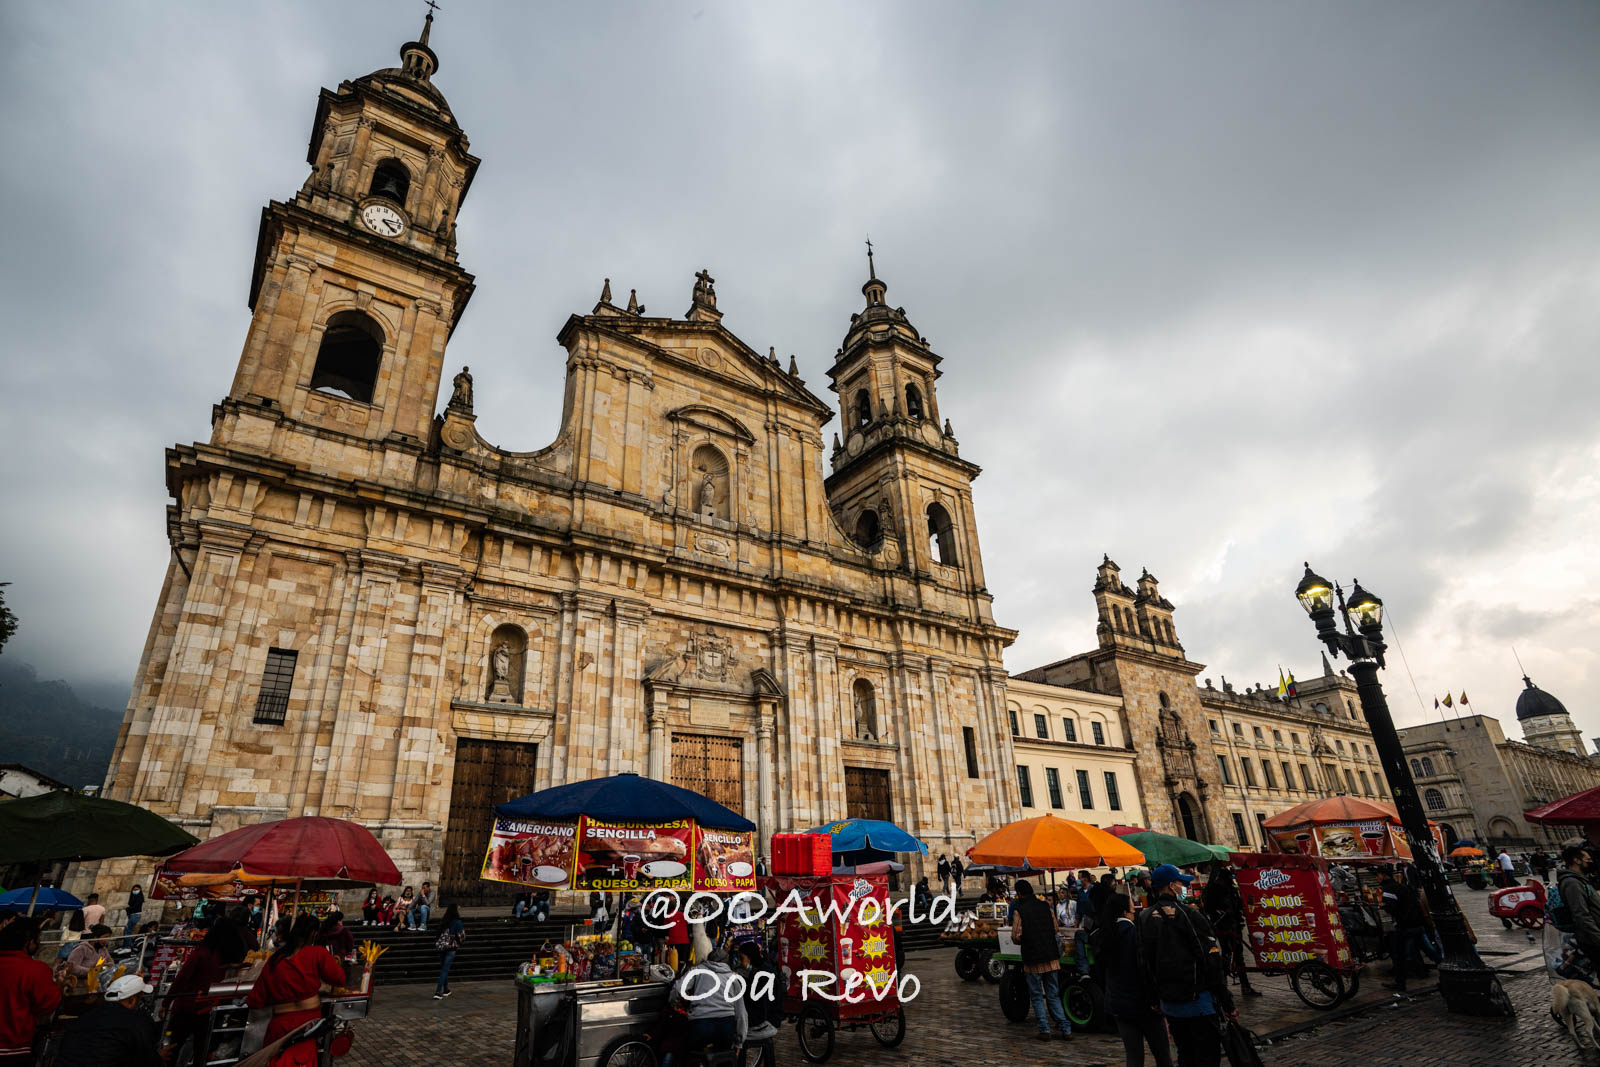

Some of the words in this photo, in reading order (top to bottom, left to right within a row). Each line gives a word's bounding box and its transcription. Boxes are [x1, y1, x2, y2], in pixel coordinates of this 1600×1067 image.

[508, 822, 575, 837] AMERICANO
[586, 829, 656, 840] SENCILLA
[704, 833, 741, 845] SENCILLO
[644, 864, 651, 873] $
[592, 880, 639, 888] QUESO
[654, 879, 688, 888] PAPA
[704, 877, 728, 887] QUESO
[735, 878, 755, 887] PAPA
[1260, 896, 1268, 909] $
[1269, 895, 1302, 908] 1.000
[1257, 915, 1265, 928] $
[1268, 914, 1300, 927] 1.000
[1267, 930, 1276, 943] $
[1277, 930, 1312, 942] 1.200
[1259, 951, 1268, 963] $
[1270, 951, 1309, 963] 2.000
